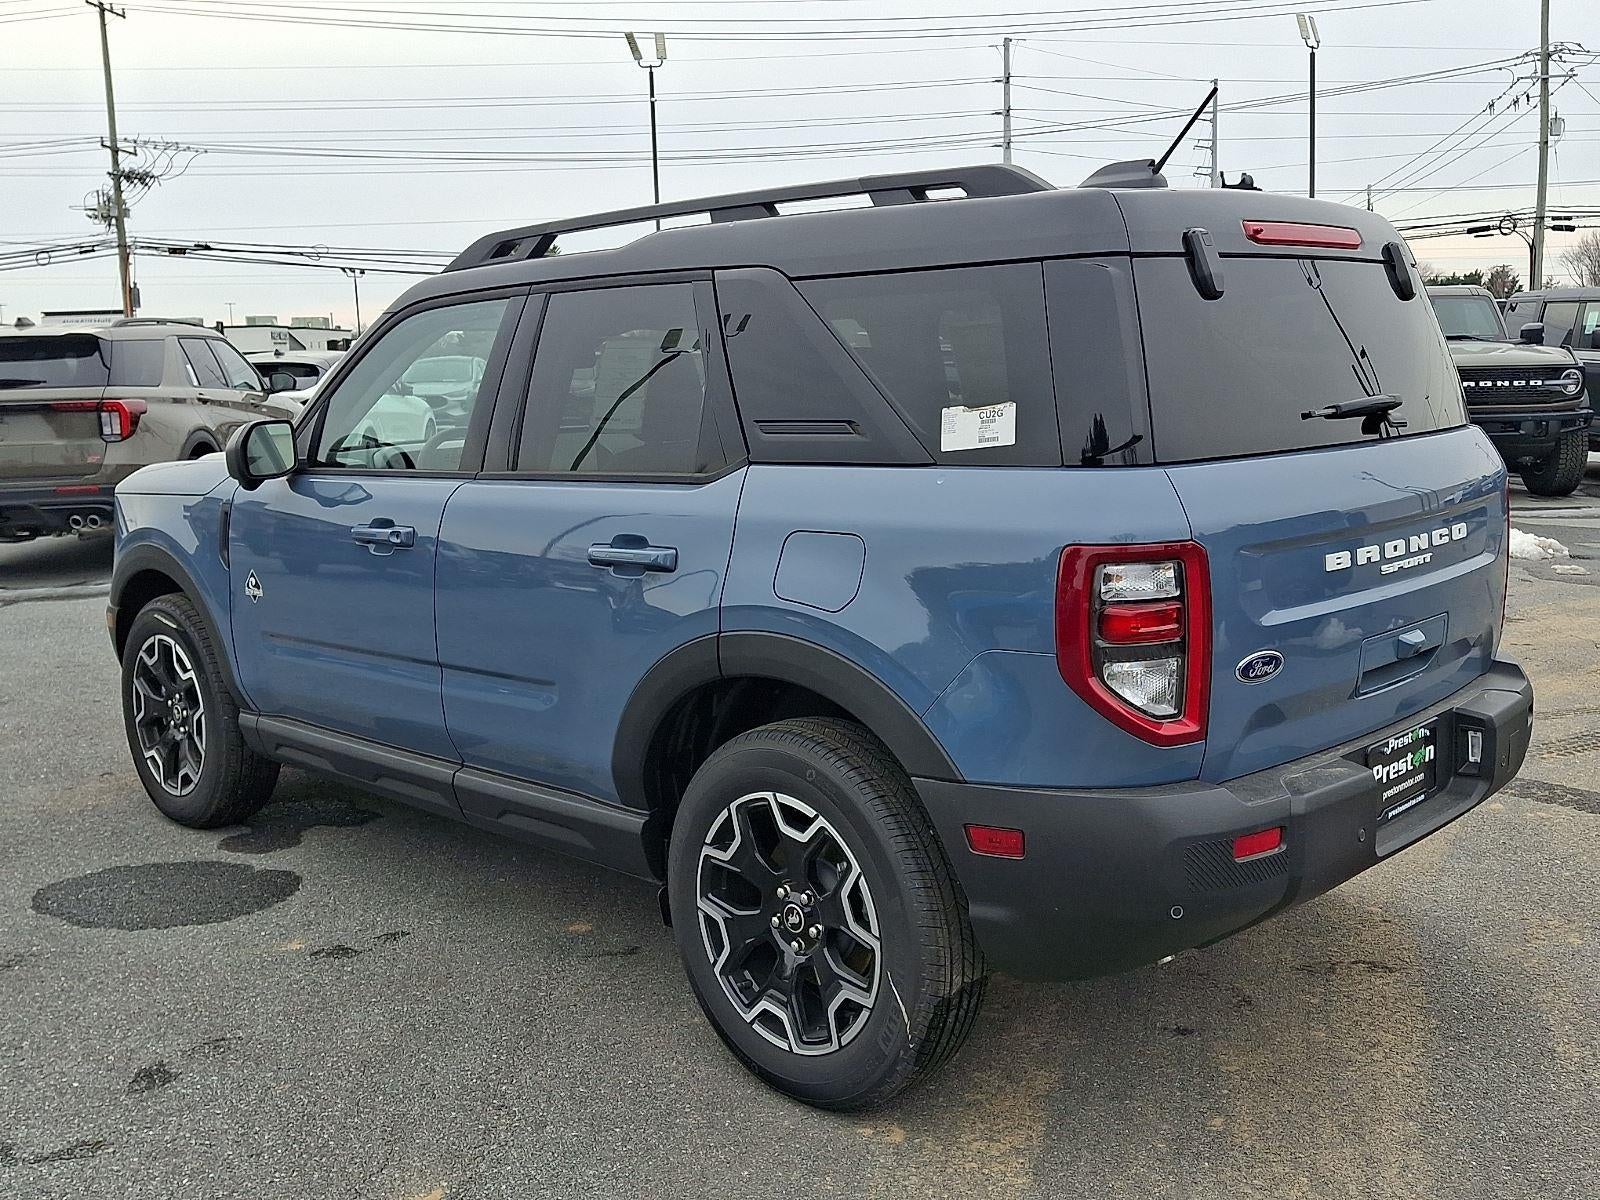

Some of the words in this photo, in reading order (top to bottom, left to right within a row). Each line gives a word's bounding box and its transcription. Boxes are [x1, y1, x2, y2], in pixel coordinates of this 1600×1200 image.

[978, 409, 1004, 420] CU2G
[1325, 522, 1467, 572] BRONCO
[1380, 552, 1433, 575] SPORT
[1249, 657, 1276, 678] Ford
[1372, 743, 1435, 784] Preston
[1382, 772, 1425, 802] prestonmotor.com
